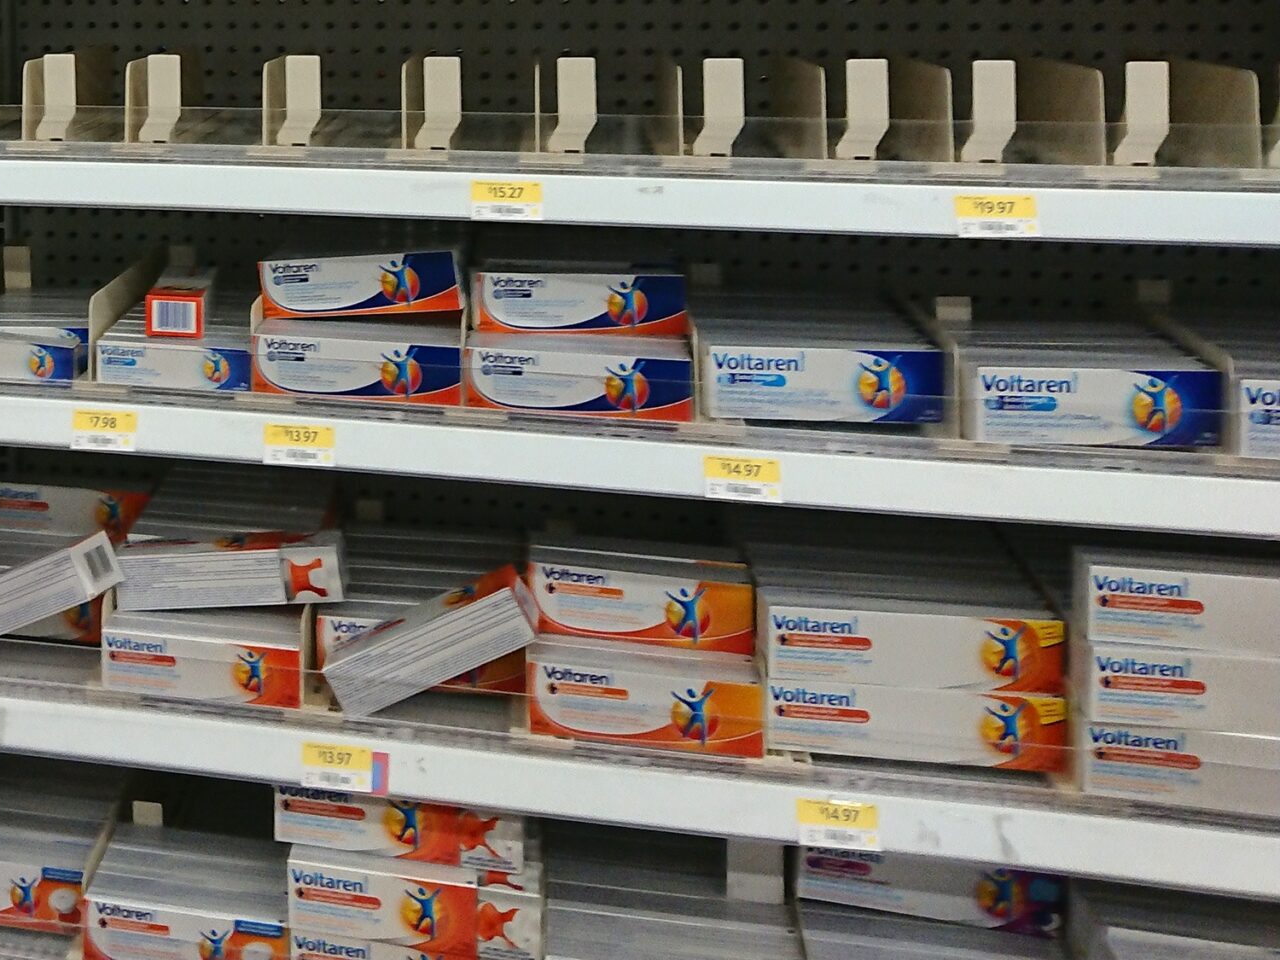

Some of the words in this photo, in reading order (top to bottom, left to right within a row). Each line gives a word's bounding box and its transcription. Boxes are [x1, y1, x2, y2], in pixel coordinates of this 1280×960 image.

[269, 263, 318, 275] Voltaren
[490, 276, 544, 289] Voltaren
[264, 339, 317, 352] Voltaren
[479, 351, 536, 365] Voltaren
[712, 352, 799, 372] Voltaren
[980, 374, 1072, 393] Voltaren
[543, 566, 606, 585] Voltaren
[1093, 575, 1182, 597] Voltaren
[773, 615, 853, 635] Voltaren
[105, 636, 164, 653] Voltaren
[543, 665, 610, 685] Voltaren
[1096, 655, 1184, 677] Voltaren
[771, 686, 850, 707] Voltaren
[1089, 726, 1179, 751] Voltaren
[291, 868, 364, 892] Voltaren
[95, 901, 153, 921] Voltaren
[294, 935, 366, 959] Voltaren
